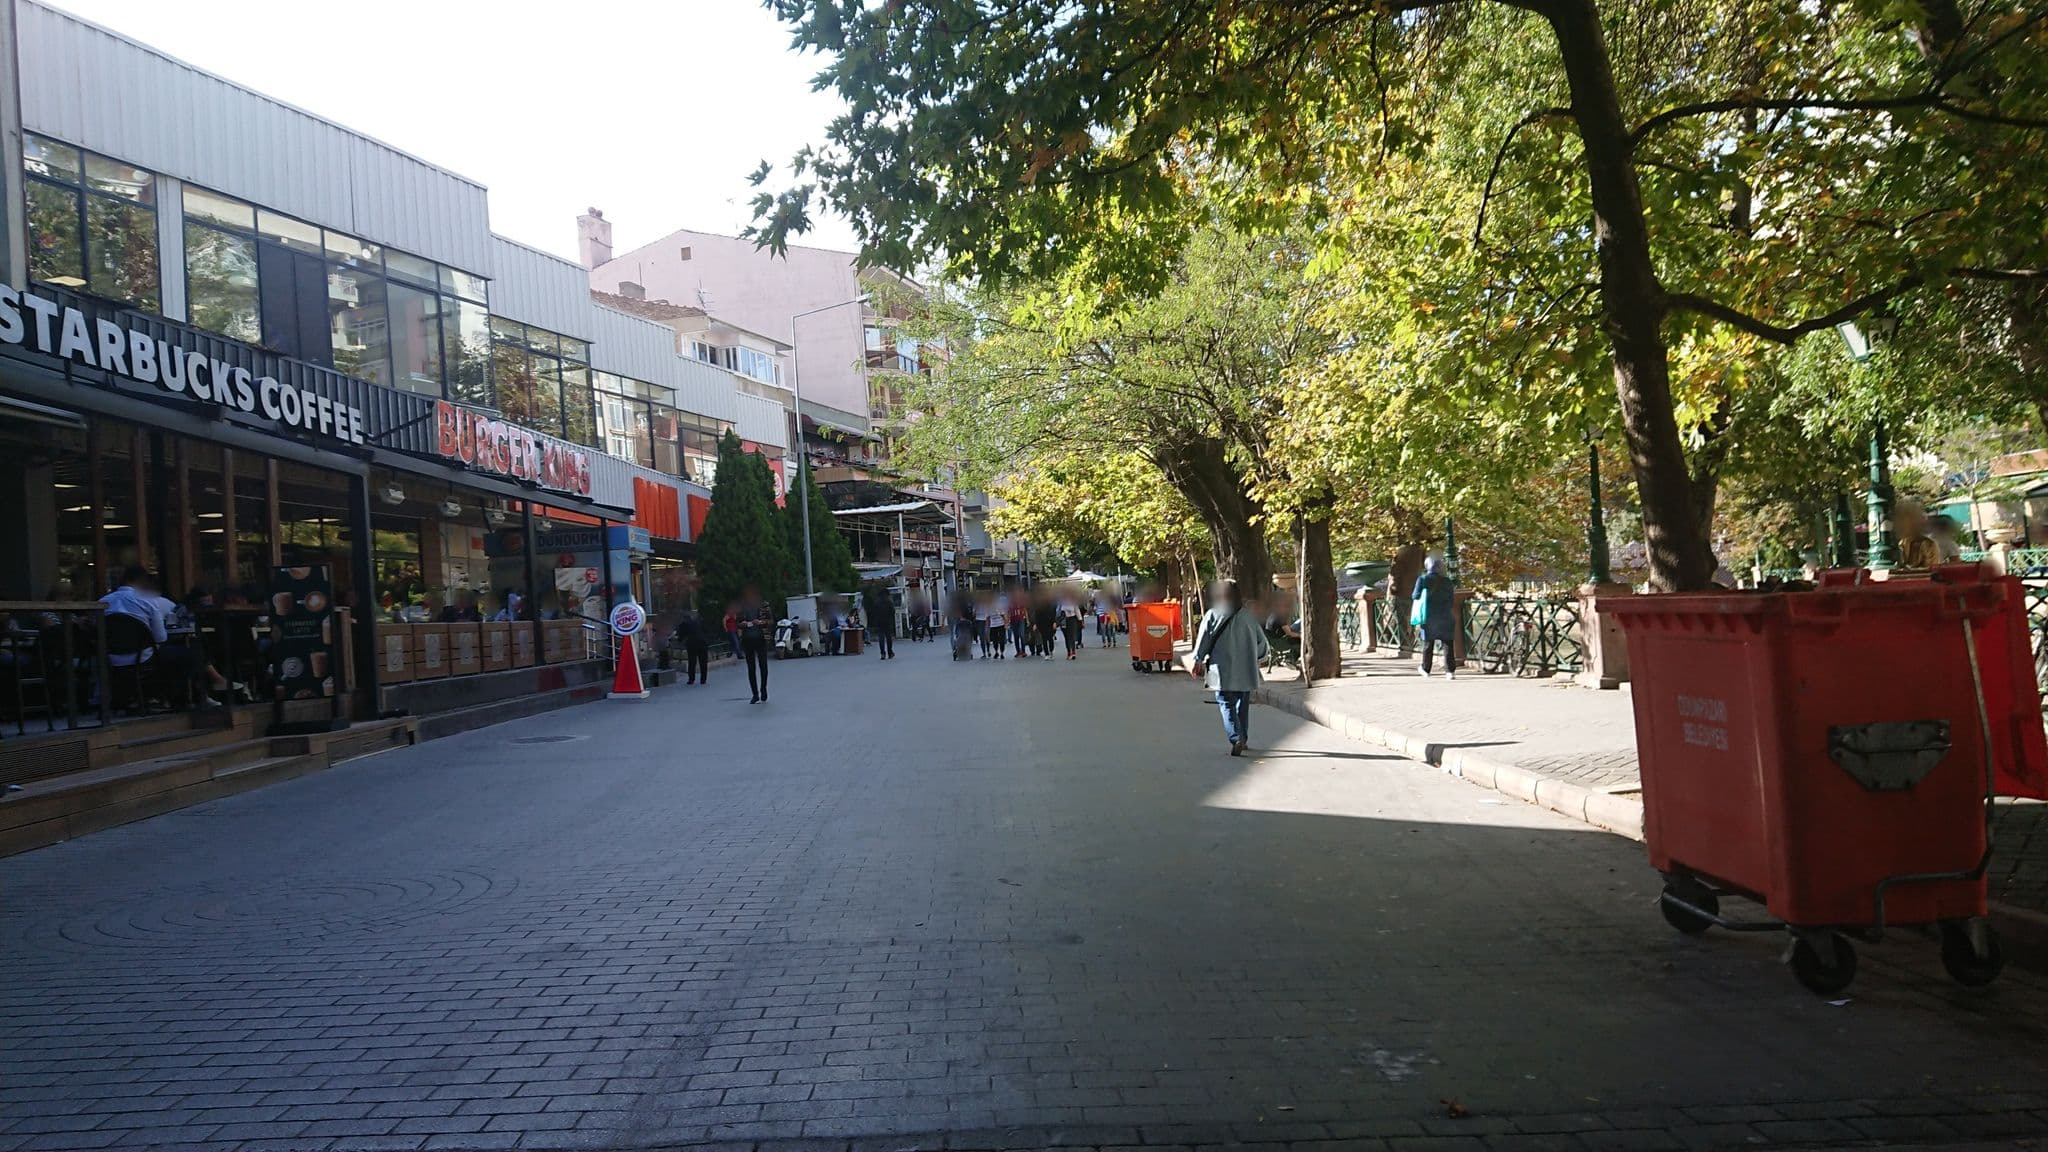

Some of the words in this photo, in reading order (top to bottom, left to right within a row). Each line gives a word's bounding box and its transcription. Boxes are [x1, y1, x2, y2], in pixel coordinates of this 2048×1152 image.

[0, 283, 255, 412] STARBUCKS
[259, 376, 364, 445] COFFEE
[437, 399, 541, 482] BURGER
[542, 439, 591, 496] KING
[616, 614, 638, 627] KING
